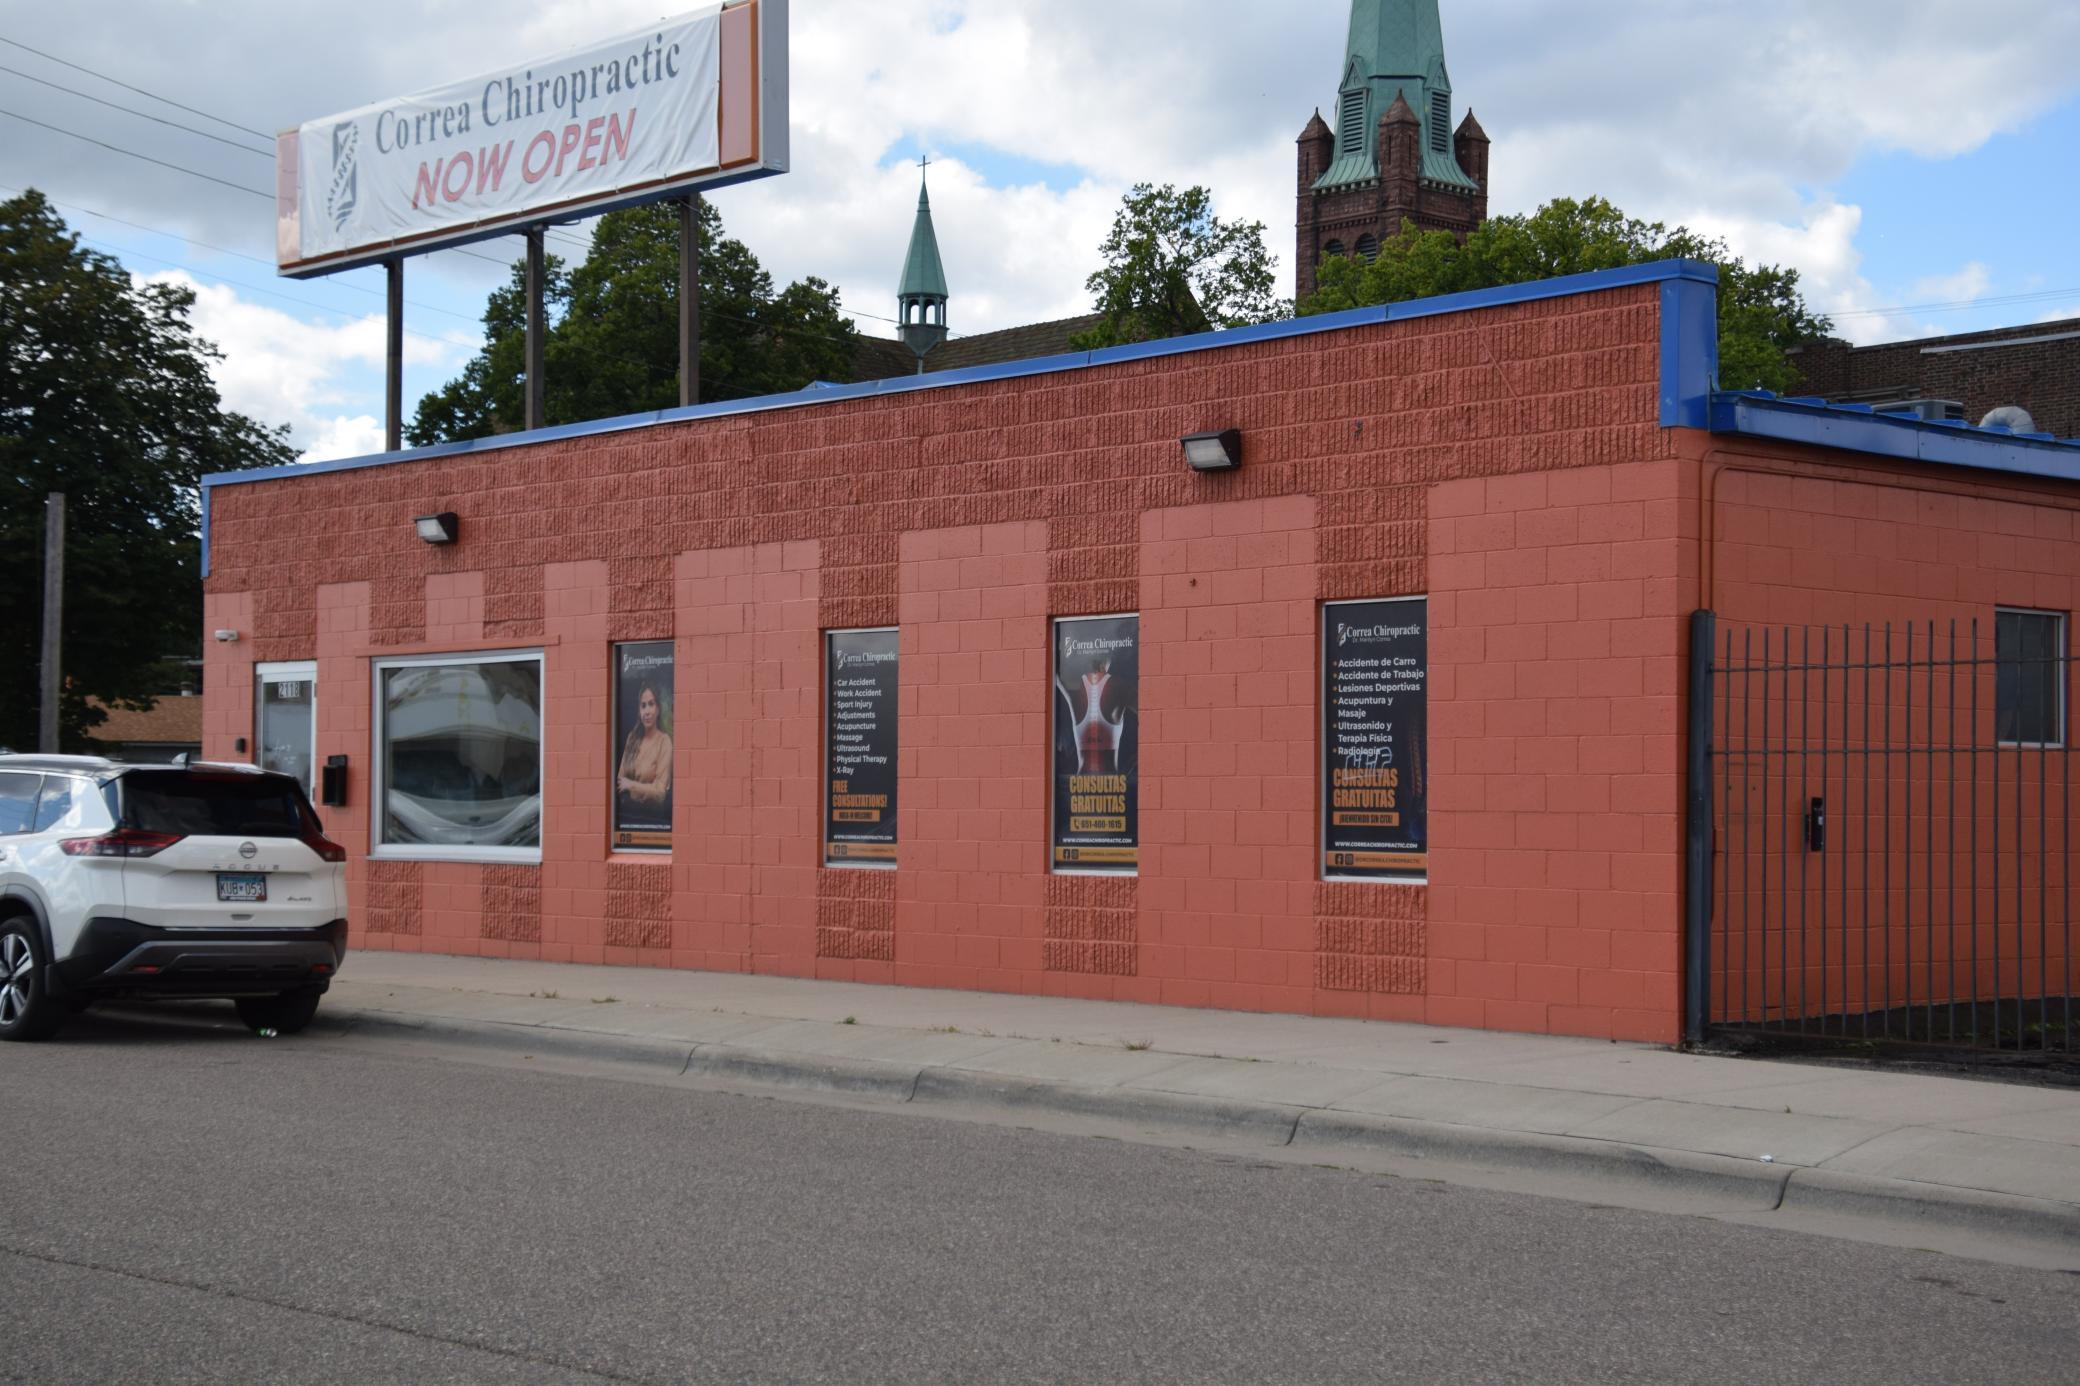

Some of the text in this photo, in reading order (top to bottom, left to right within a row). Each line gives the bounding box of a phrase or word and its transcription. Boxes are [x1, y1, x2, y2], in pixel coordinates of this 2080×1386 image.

[375, 33, 680, 155] Correa Chiropractic
[411, 108, 637, 210] NOW OPEN
[1346, 623, 1421, 639] Correa Chiropractic
[1338, 657, 1416, 667] Accidente de Carro
[1338, 669, 1425, 680] Accidente de Trabajo
[837, 678, 876, 687] Car Accident
[1338, 682, 1421, 693] Lesiones Deportivas
[279, 683, 299, 697] 2118
[837, 688, 882, 697] Work Accident
[837, 699, 873, 710] Sport Injury
[1338, 696, 1393, 706] Acupuntura y
[837, 711, 876, 720] Adjustments
[1338, 709, 1367, 719] Masaje
[837, 722, 876, 731] Acupuncture
[1338, 720, 1392, 731] Ultrasonido y
[836, 734, 863, 742] Massage
[1338, 733, 1368, 744] Terapia
[836, 744, 870, 752] Ultrasound
[836, 754, 887, 764] Physical Therapy
[836, 766, 854, 775] X-Ray
[1333, 767, 1398, 787] CONSULTAS
[832, 780, 848, 793] FREE
[1069, 774, 1127, 793] CONSULTAS
[1071, 794, 1126, 813] GRATUITAS
[1333, 788, 1396, 808] GRATUITAS
